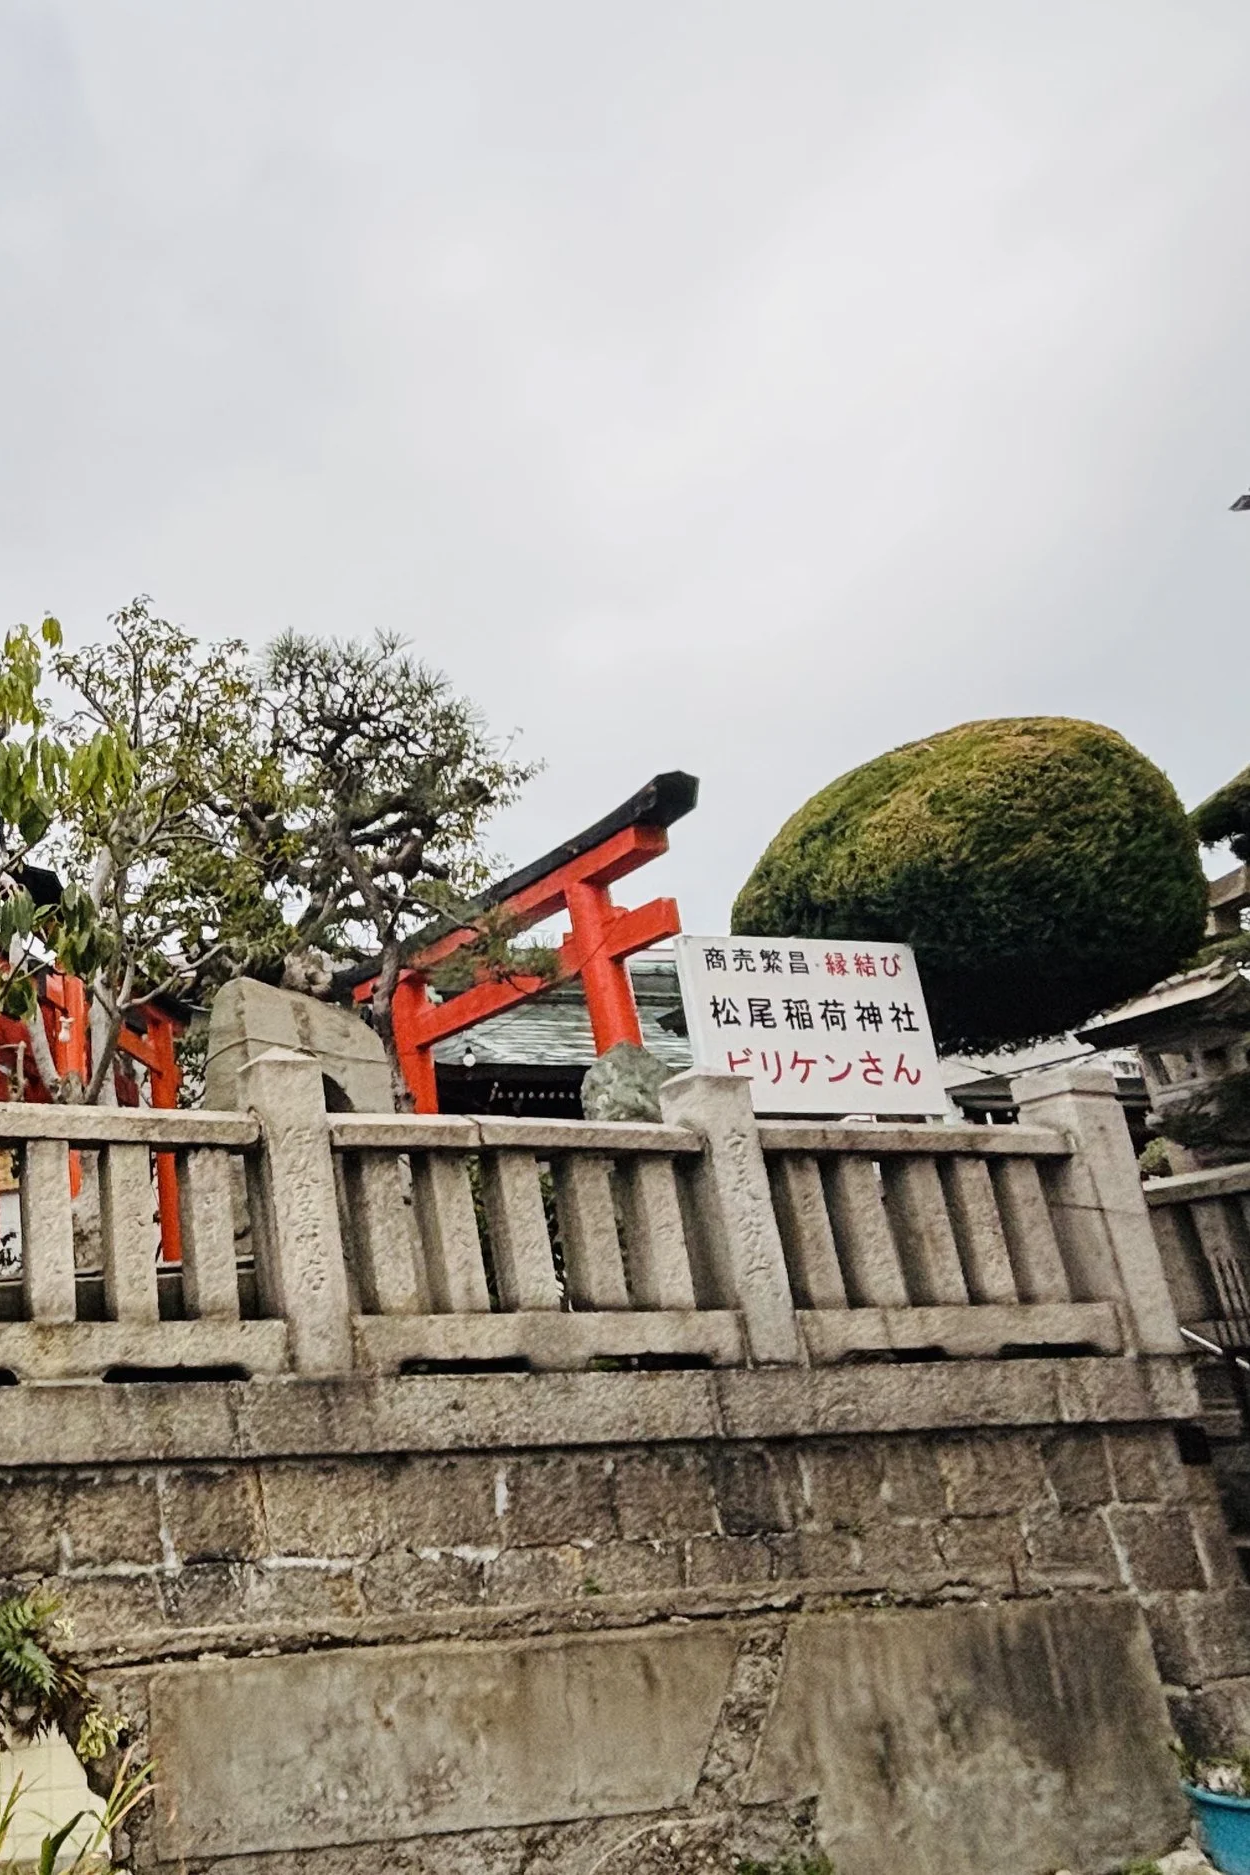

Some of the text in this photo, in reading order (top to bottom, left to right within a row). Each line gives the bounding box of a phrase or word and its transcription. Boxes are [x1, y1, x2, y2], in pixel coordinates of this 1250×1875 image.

[710, 995, 920, 1033] 松尾稲荷神社
[726, 1048, 922, 1086] ビリケンさん
